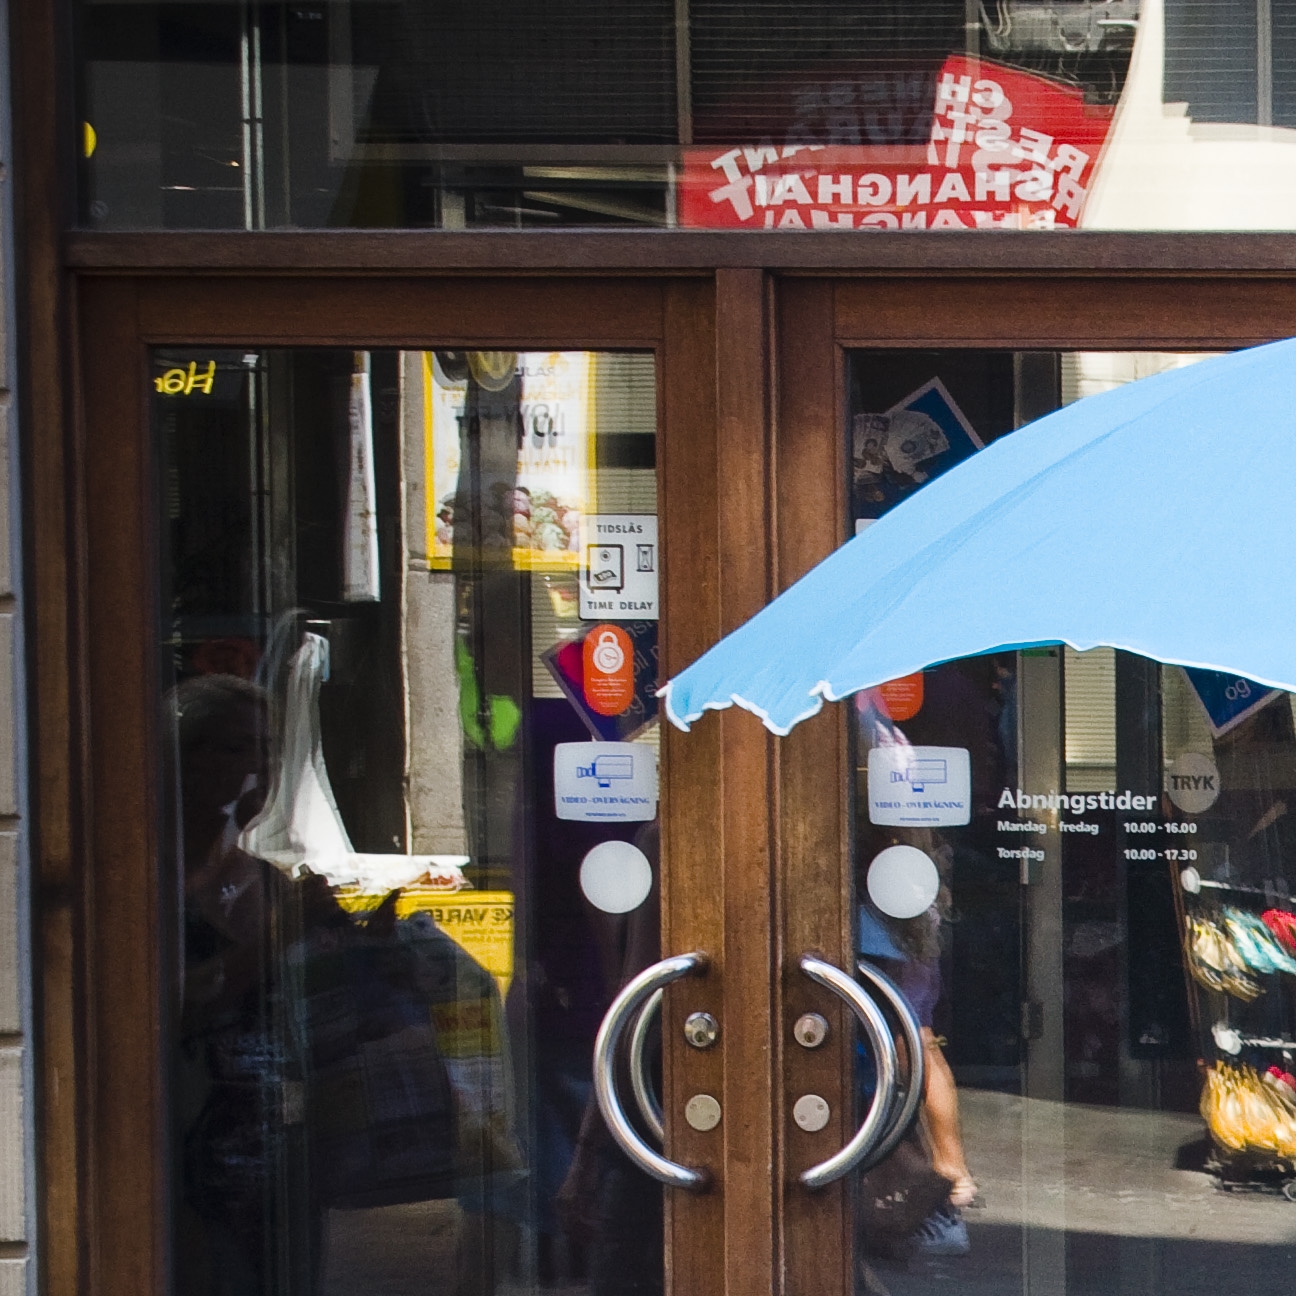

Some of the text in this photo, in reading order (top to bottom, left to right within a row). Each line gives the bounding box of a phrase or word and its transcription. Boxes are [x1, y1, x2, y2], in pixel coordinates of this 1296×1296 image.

[596, 522, 643, 534] TIDSLÅS
[587, 601, 653, 611] TIME DELAY
[1171, 775, 1215, 791] TRYK
[998, 787, 1157, 815] Åbningstider
[997, 821, 1047, 834] Mandag
[1059, 820, 1099, 835] fredag
[997, 847, 1045, 862] Torsdag
